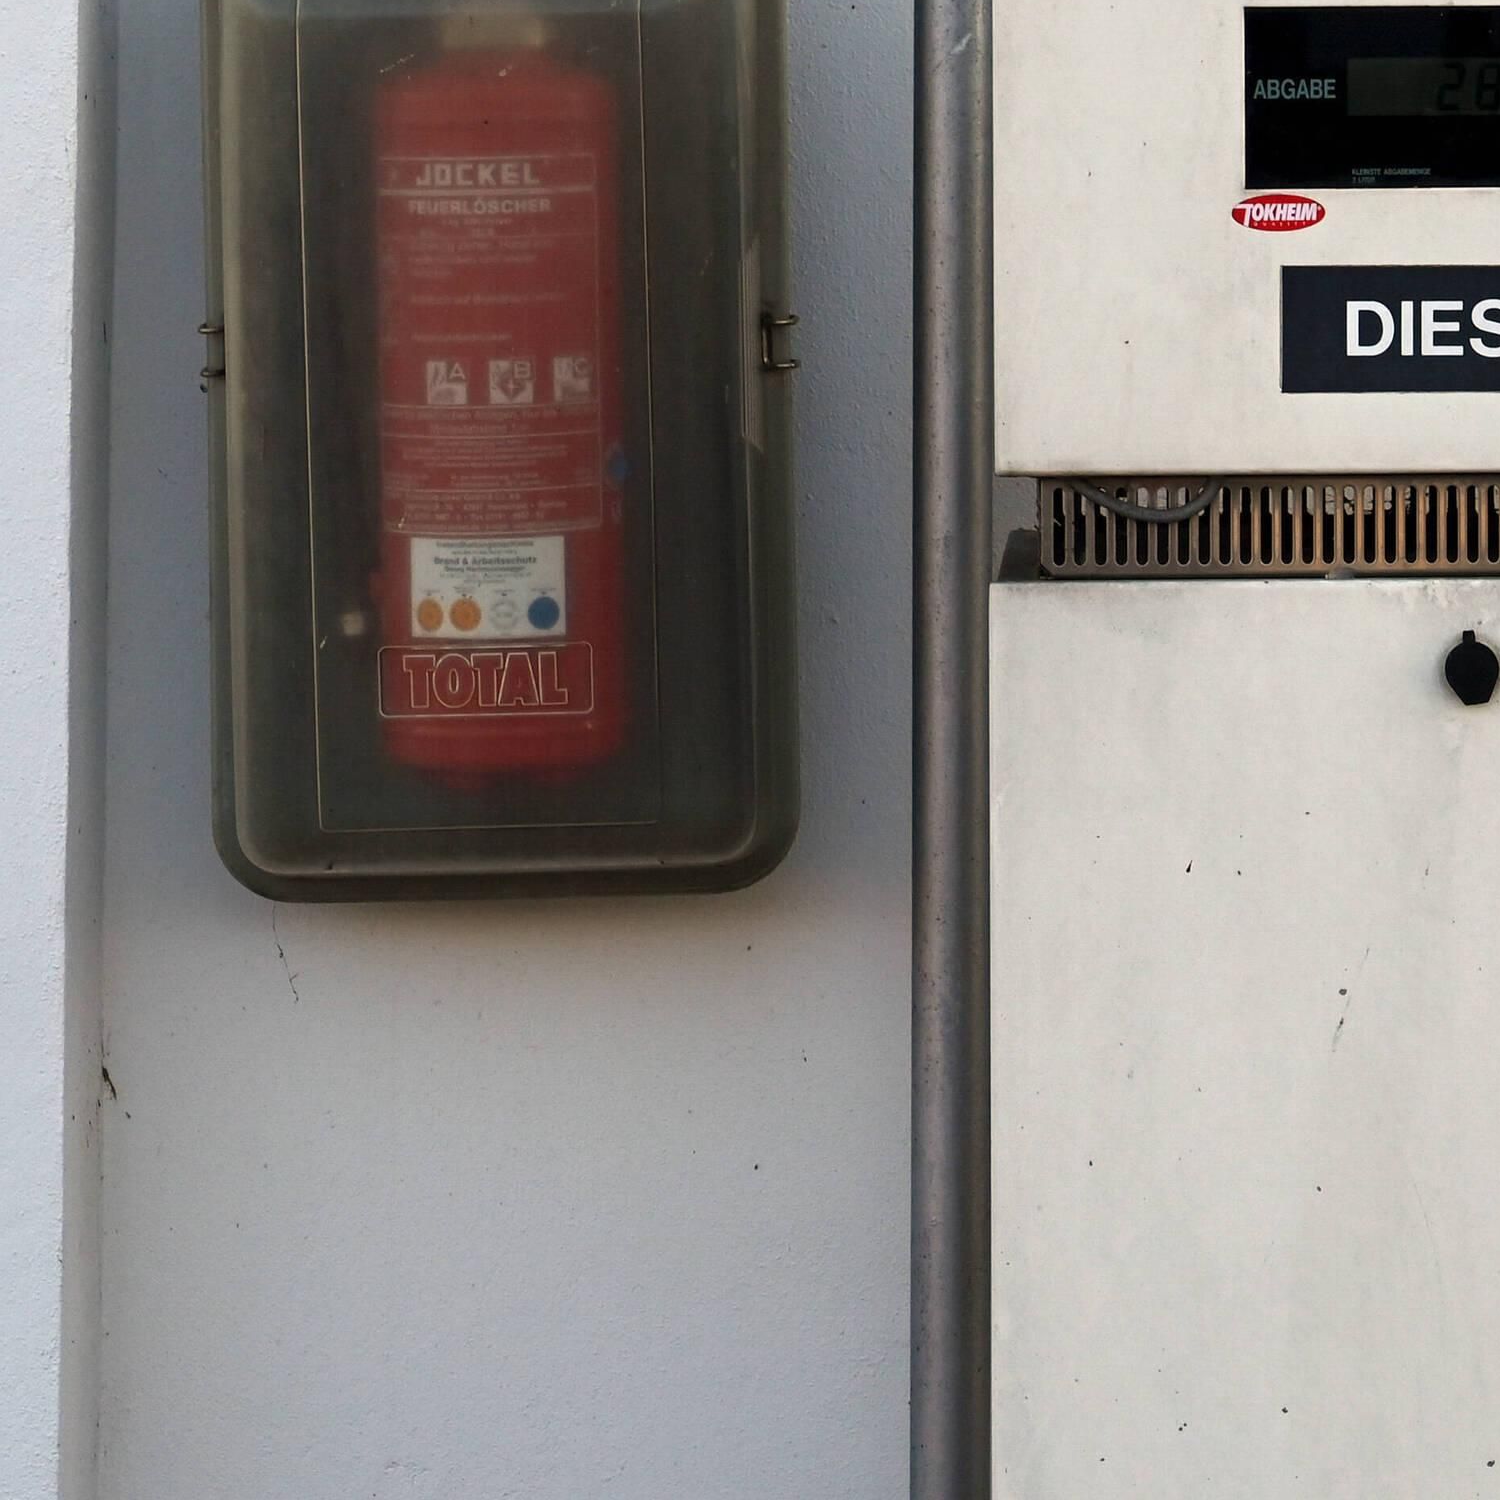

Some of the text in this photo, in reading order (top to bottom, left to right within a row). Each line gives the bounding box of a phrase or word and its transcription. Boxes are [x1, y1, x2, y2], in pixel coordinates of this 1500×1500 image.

[1253, 78, 1337, 100] ABGABE
[416, 163, 540, 187] JOCKEL
[408, 197, 552, 215] FEUERLÖSCHER
[1233, 202, 1318, 227] TOKHEIM
[449, 362, 466, 380] A
[513, 360, 531, 378] B
[402, 651, 568, 709] TOTAL
